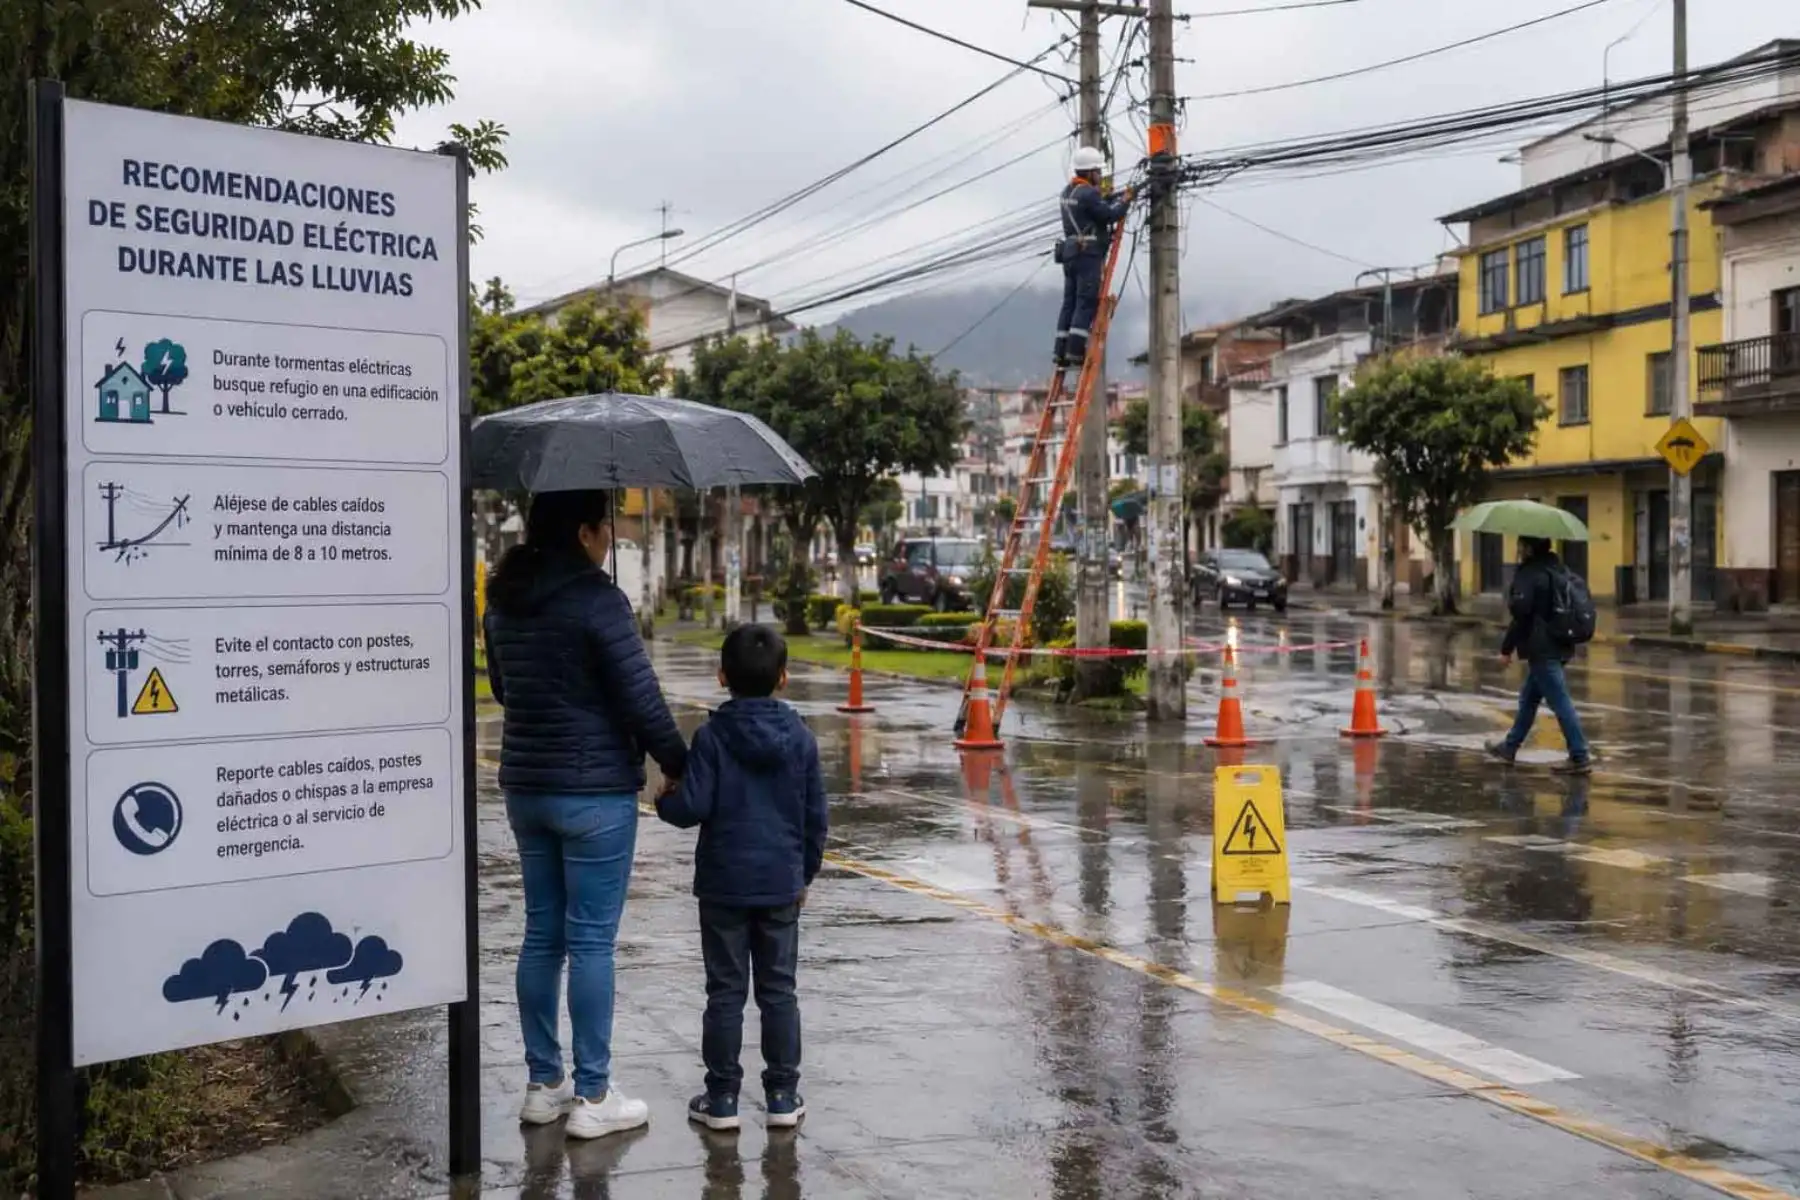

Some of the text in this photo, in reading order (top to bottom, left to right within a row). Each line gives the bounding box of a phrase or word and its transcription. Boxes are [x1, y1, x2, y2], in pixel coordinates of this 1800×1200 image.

[122, 158, 396, 217] RECOMENDACIONES
[89, 200, 438, 261] DE SEGURIDAD ELÉCTRICA
[118, 246, 413, 297] DURANTE LAS LLUVIAS
[213, 350, 412, 377] Durante tormentas eléctricas
[214, 375, 438, 401] busque refugio en una edificación
[213, 401, 347, 420] o vehículo cerrado.
[214, 495, 384, 514] Aléjese de cables caídos
[214, 521, 391, 539] y mantenga una distancia
[215, 545, 391, 560] mínima de 8 a 10 metros.
[216, 634, 413, 653] Evite el contacto con postes,
[216, 658, 430, 679] torres, semáforos y estructuras
[216, 686, 289, 703] metálicas.
[217, 755, 421, 784] Reporte cables caídos, postes
[217, 778, 433, 807] dañados o chispas a la empresa
[217, 802, 384, 832] eléctrica o al servicio de
[217, 835, 304, 858] emergencia.
